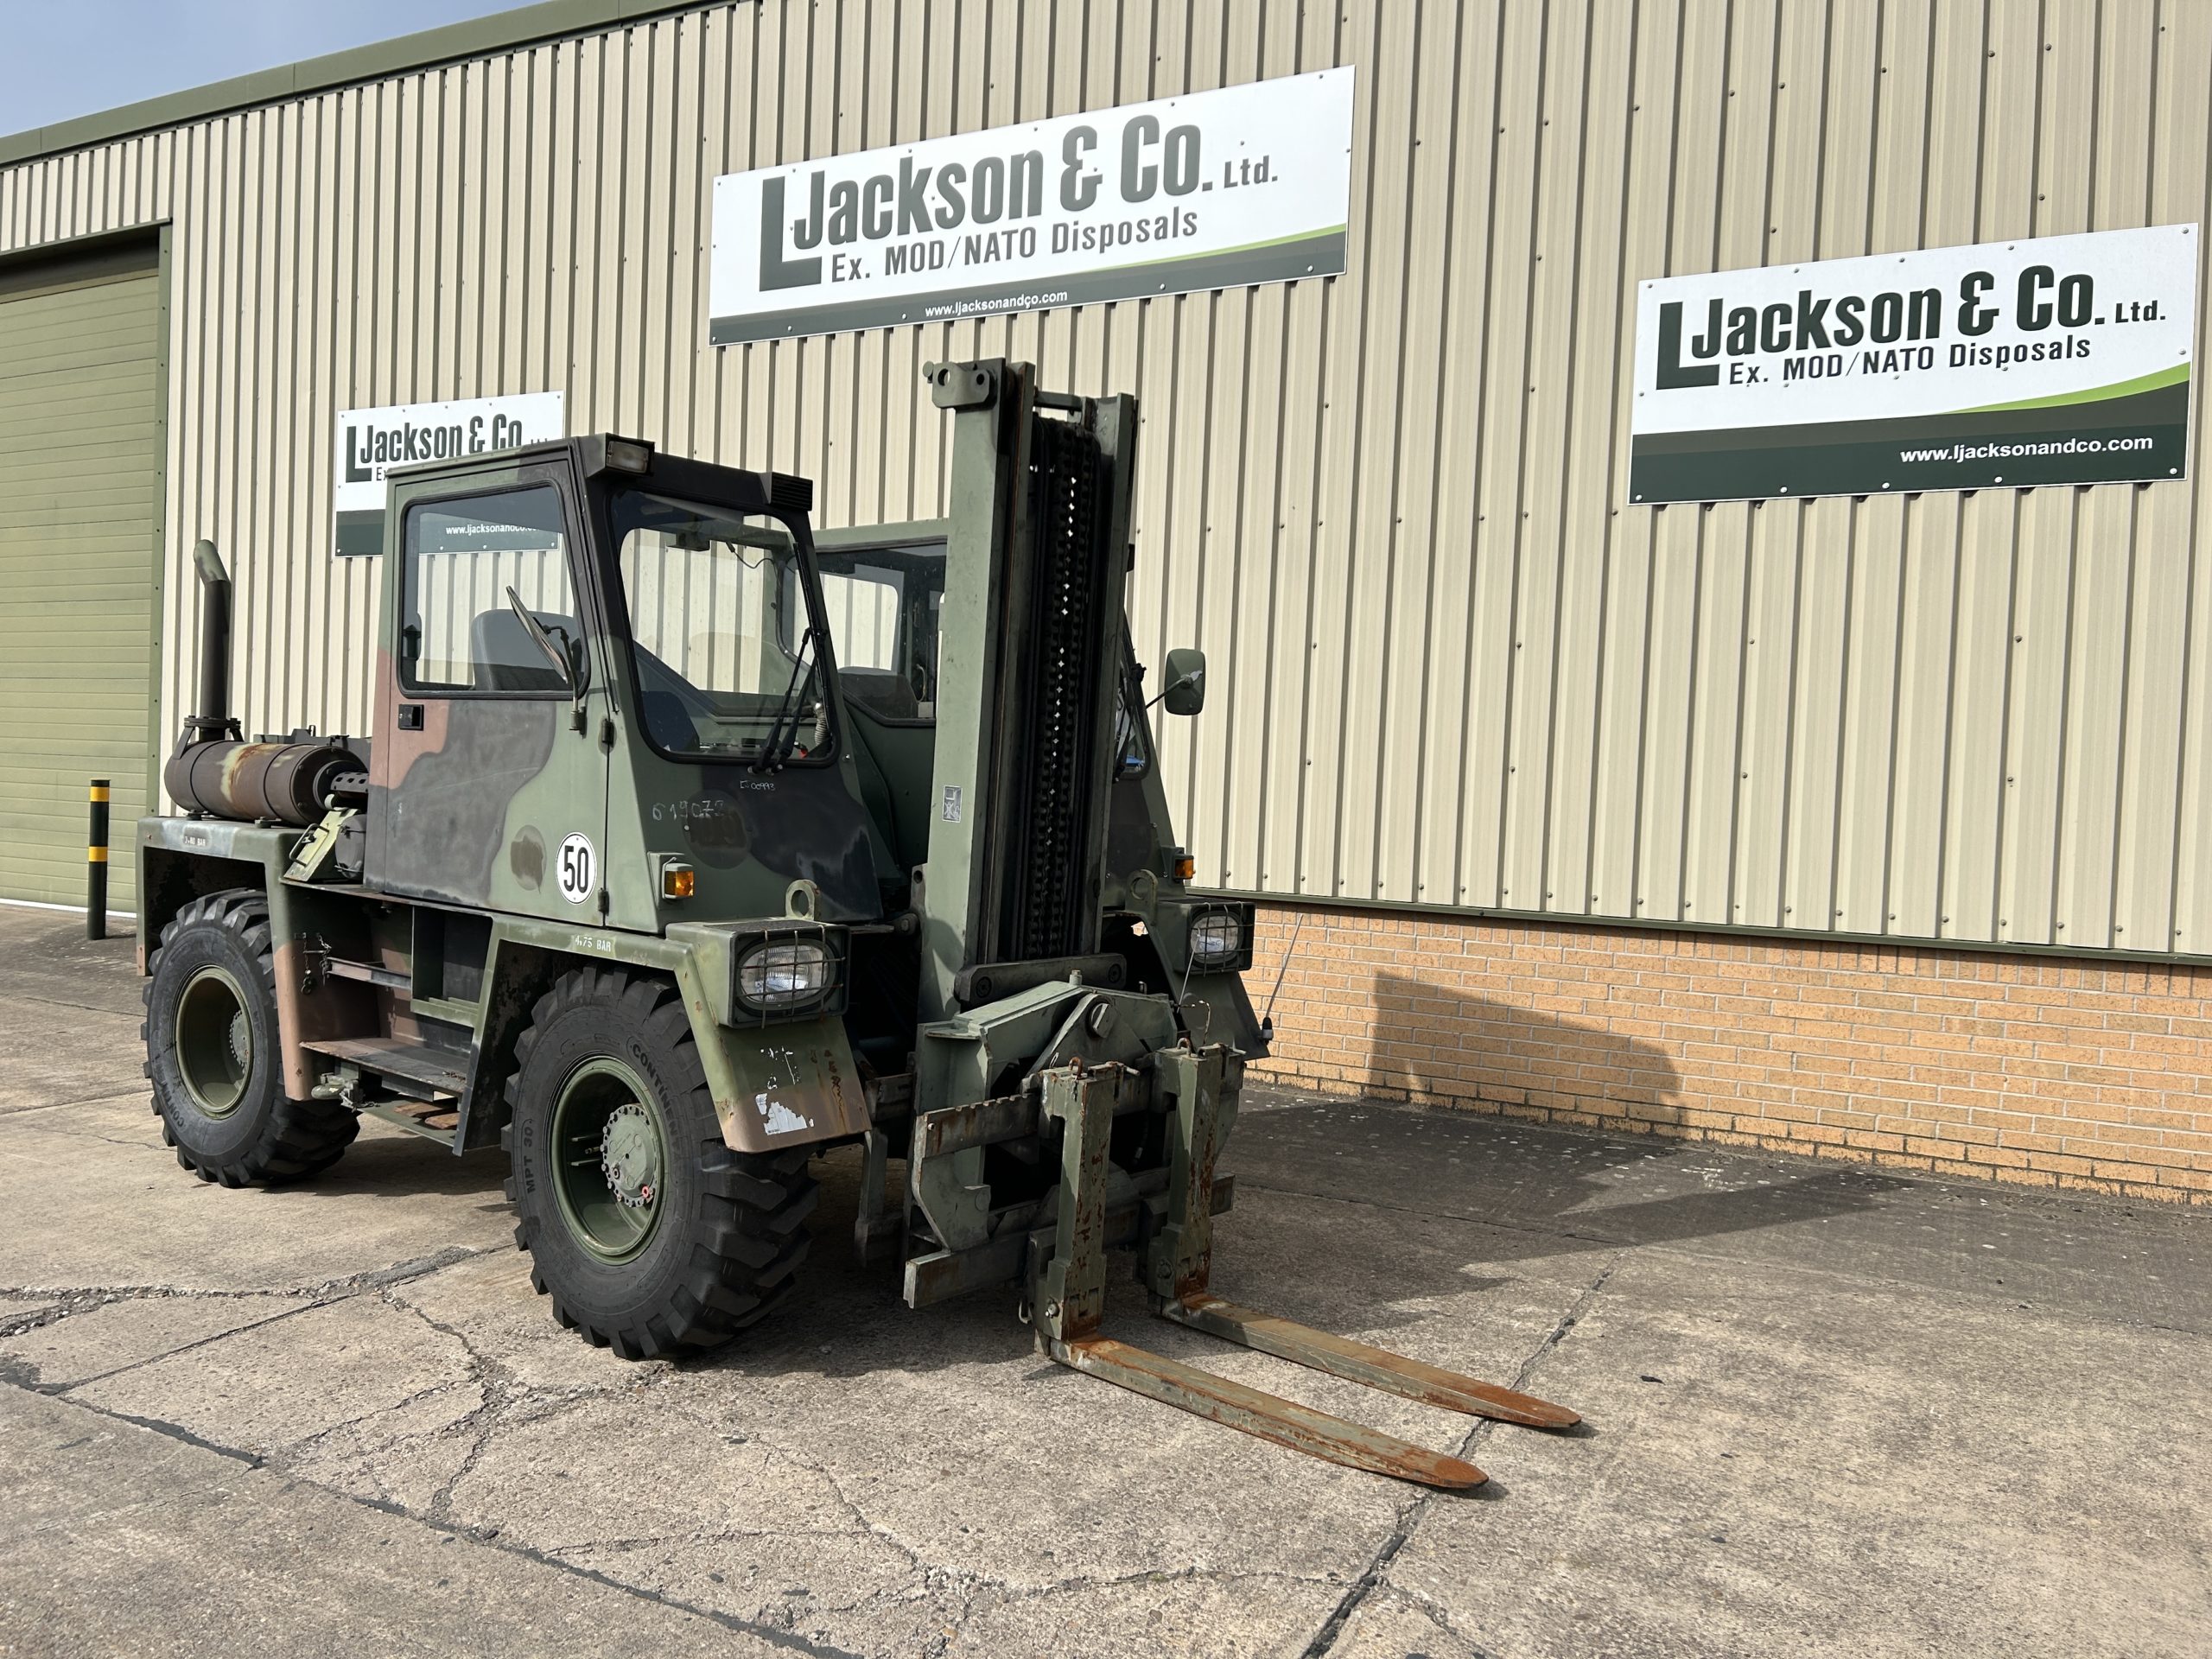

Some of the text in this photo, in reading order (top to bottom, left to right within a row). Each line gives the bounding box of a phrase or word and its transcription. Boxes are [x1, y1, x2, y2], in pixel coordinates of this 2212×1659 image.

[1059, 126, 1103, 212] &
[1120, 115, 1213, 203] Co.
[1224, 156, 1278, 188] Ltd.
[831, 207, 1198, 283] Ex. MOD/NATO Disposals
[925, 290, 1068, 317] www.ljacksonandco.com
[1957, 270, 2000, 337] &
[2016, 264, 2106, 332] Co.
[2114, 300, 2166, 324] Ltd.
[1729, 334, 2091, 385] Ex. MOD/NATO Disposals
[468, 415, 486, 454] &
[1900, 436, 2154, 463] www.ljacksonandco.com
[445, 523, 539, 537] www.ljacksonandco.
[563, 844, 589, 893] 50
[596, 939, 612, 953] BAR
[524, 1126, 536, 1194] MPT 30
